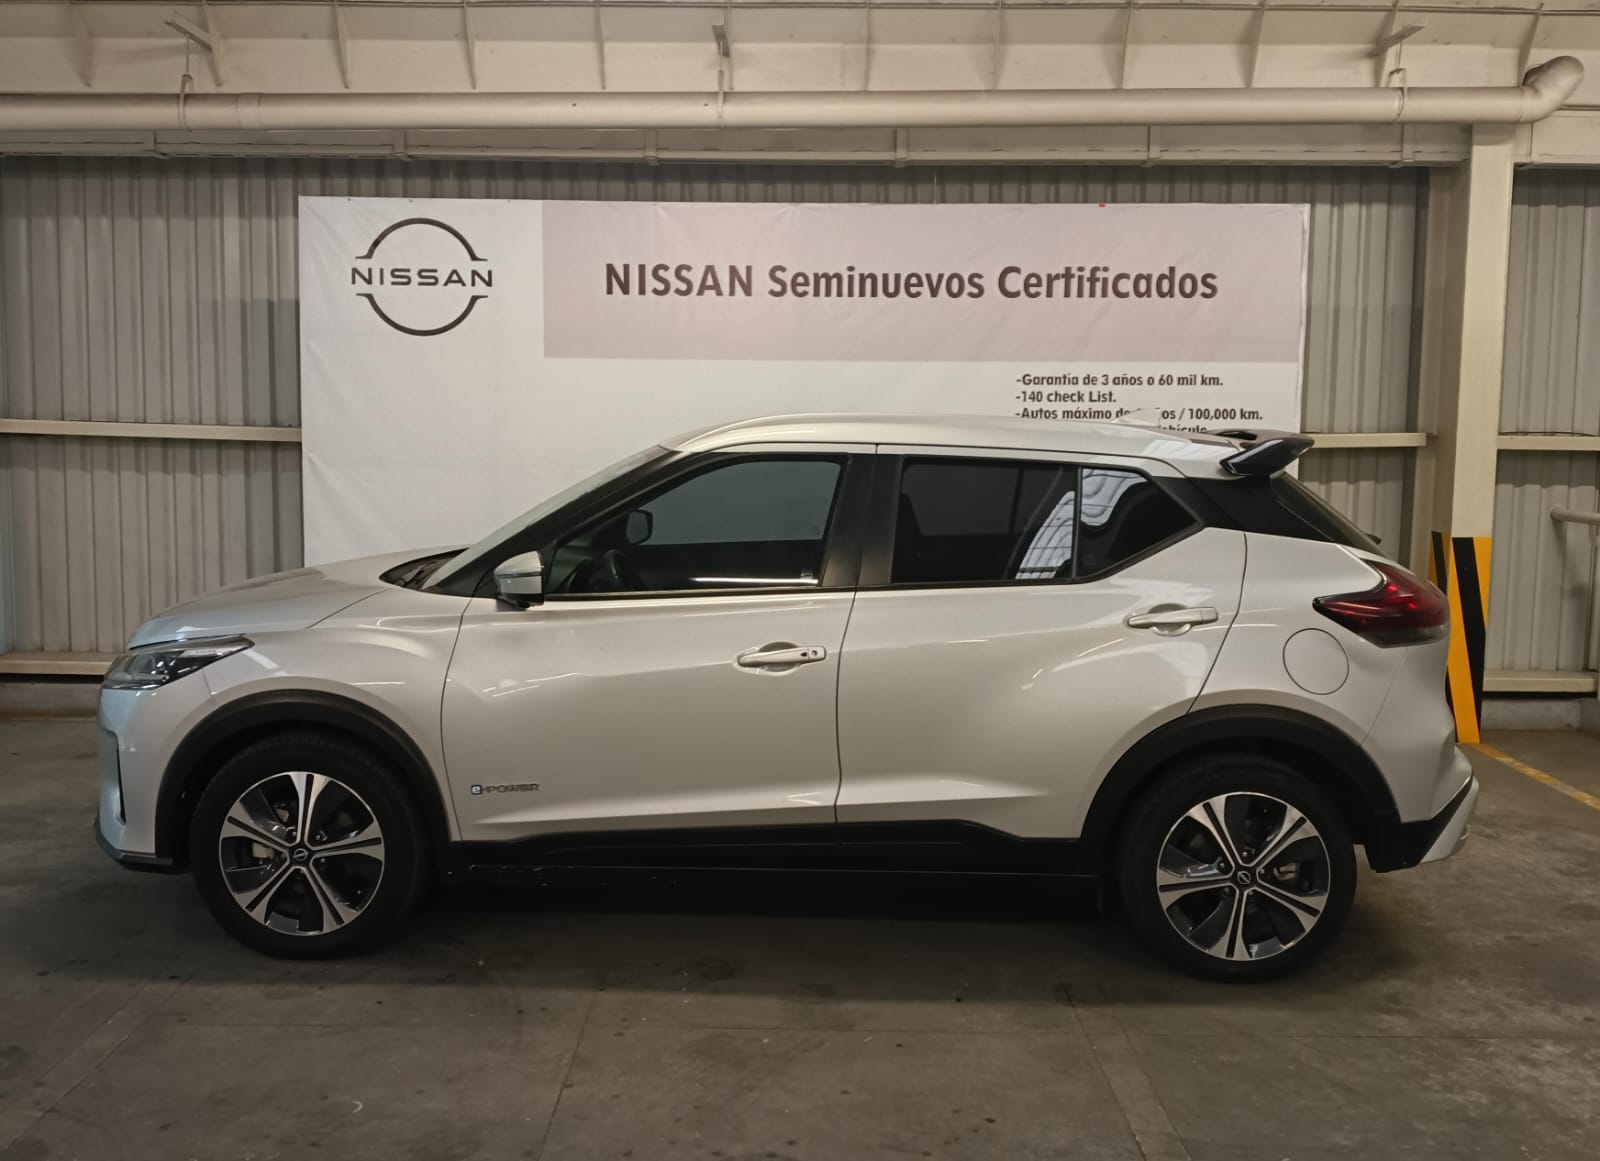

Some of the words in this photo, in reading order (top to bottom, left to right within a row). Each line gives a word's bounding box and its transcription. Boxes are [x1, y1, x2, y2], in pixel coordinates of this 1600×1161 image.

[351, 267, 493, 287] NISSAN
[606, 263, 752, 296] NISSAN
[768, 265, 985, 299] Seminuevos
[998, 266, 1219, 299] Certificados
[1016, 373, 1079, 386] -Garantía
[1083, 374, 1098, 386] de
[1101, 374, 1109, 386] 3
[1112, 373, 1143, 386] años
[1147, 377, 1155, 386] o
[1158, 374, 1173, 386] 60
[1177, 374, 1197, 386] mil
[1200, 374, 1223, 386] km.
[1016, 391, 1043, 403] -140
[1046, 391, 1086, 403] check
[1089, 391, 1116, 403] List.
[1016, 408, 1058, 420] -Autos
[1062, 407, 1112, 420] máximo
[1188, 408, 1236, 421] 100,000
[1240, 407, 1263, 420] km.
